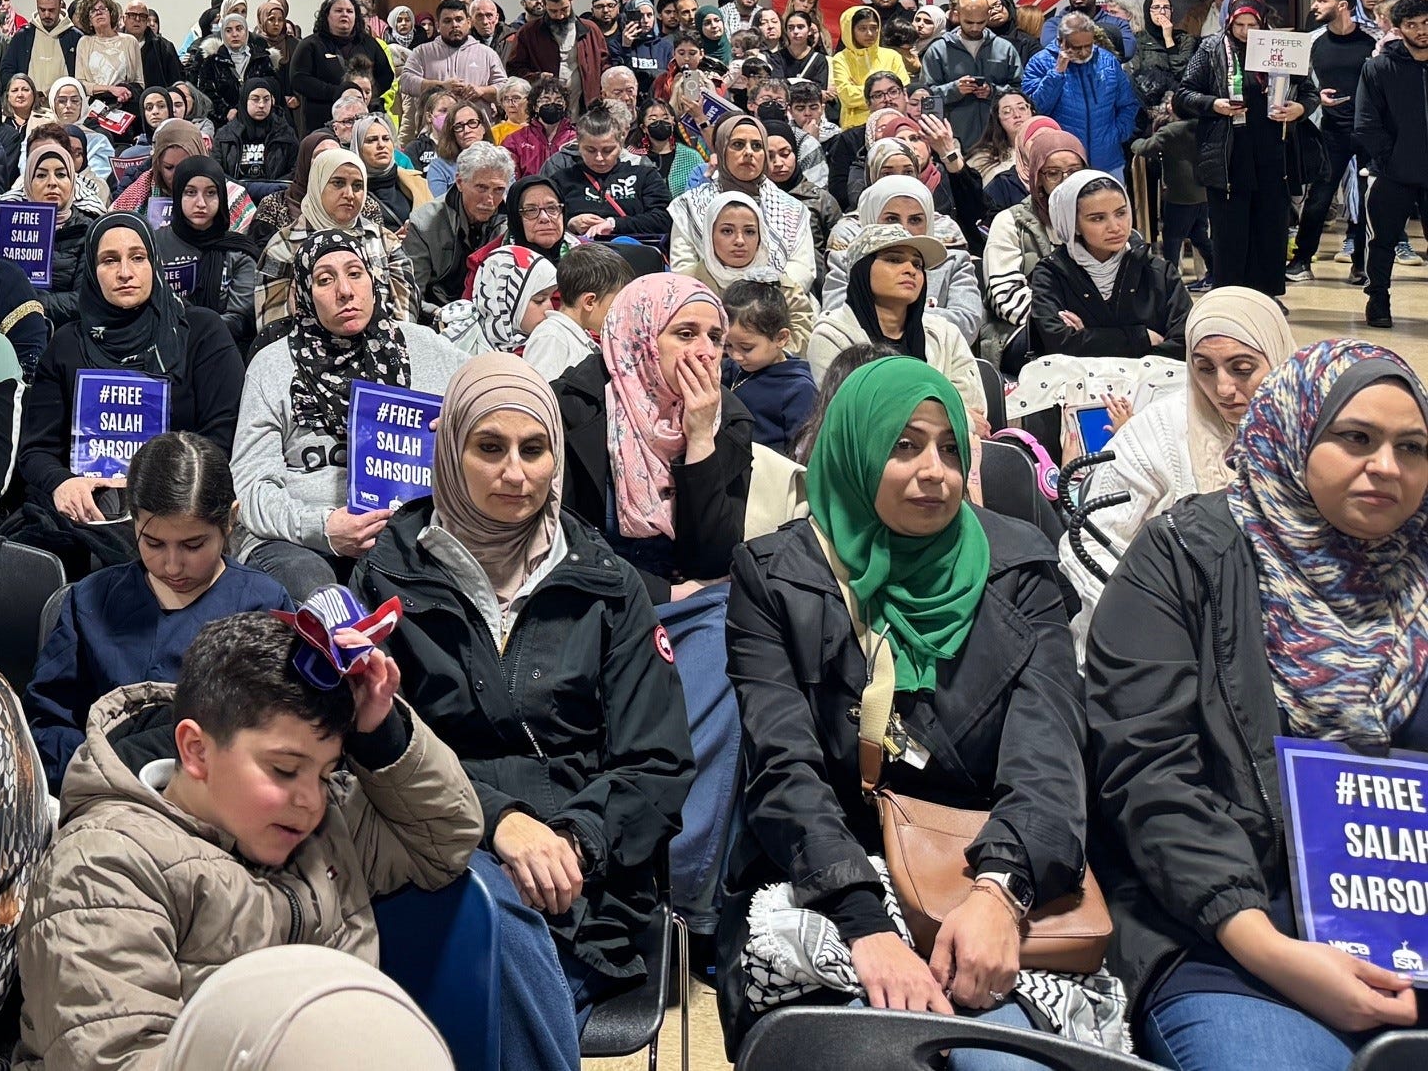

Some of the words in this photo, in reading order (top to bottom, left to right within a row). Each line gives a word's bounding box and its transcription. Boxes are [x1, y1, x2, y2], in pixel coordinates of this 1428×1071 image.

[1257, 37, 1265, 46] I
[1272, 38, 1303, 47] PREFER
[1262, 60, 1297, 68] CRUSHED
[11, 211, 40, 225] #FREE
[10, 229, 39, 243] SALAH
[3, 247, 43, 261] SARSOUR
[99, 384, 143, 405] #FREE
[100, 412, 143, 433] SALAH
[376, 402, 424, 429] #FREE
[88, 438, 146, 460] SARSOU
[376, 430, 422, 457] SALAH
[365, 456, 432, 487] SARSOUR
[1335, 771, 1427, 813] #FREE
[1344, 822, 1428, 864] SALAH
[1329, 872, 1428, 916] SARSO
